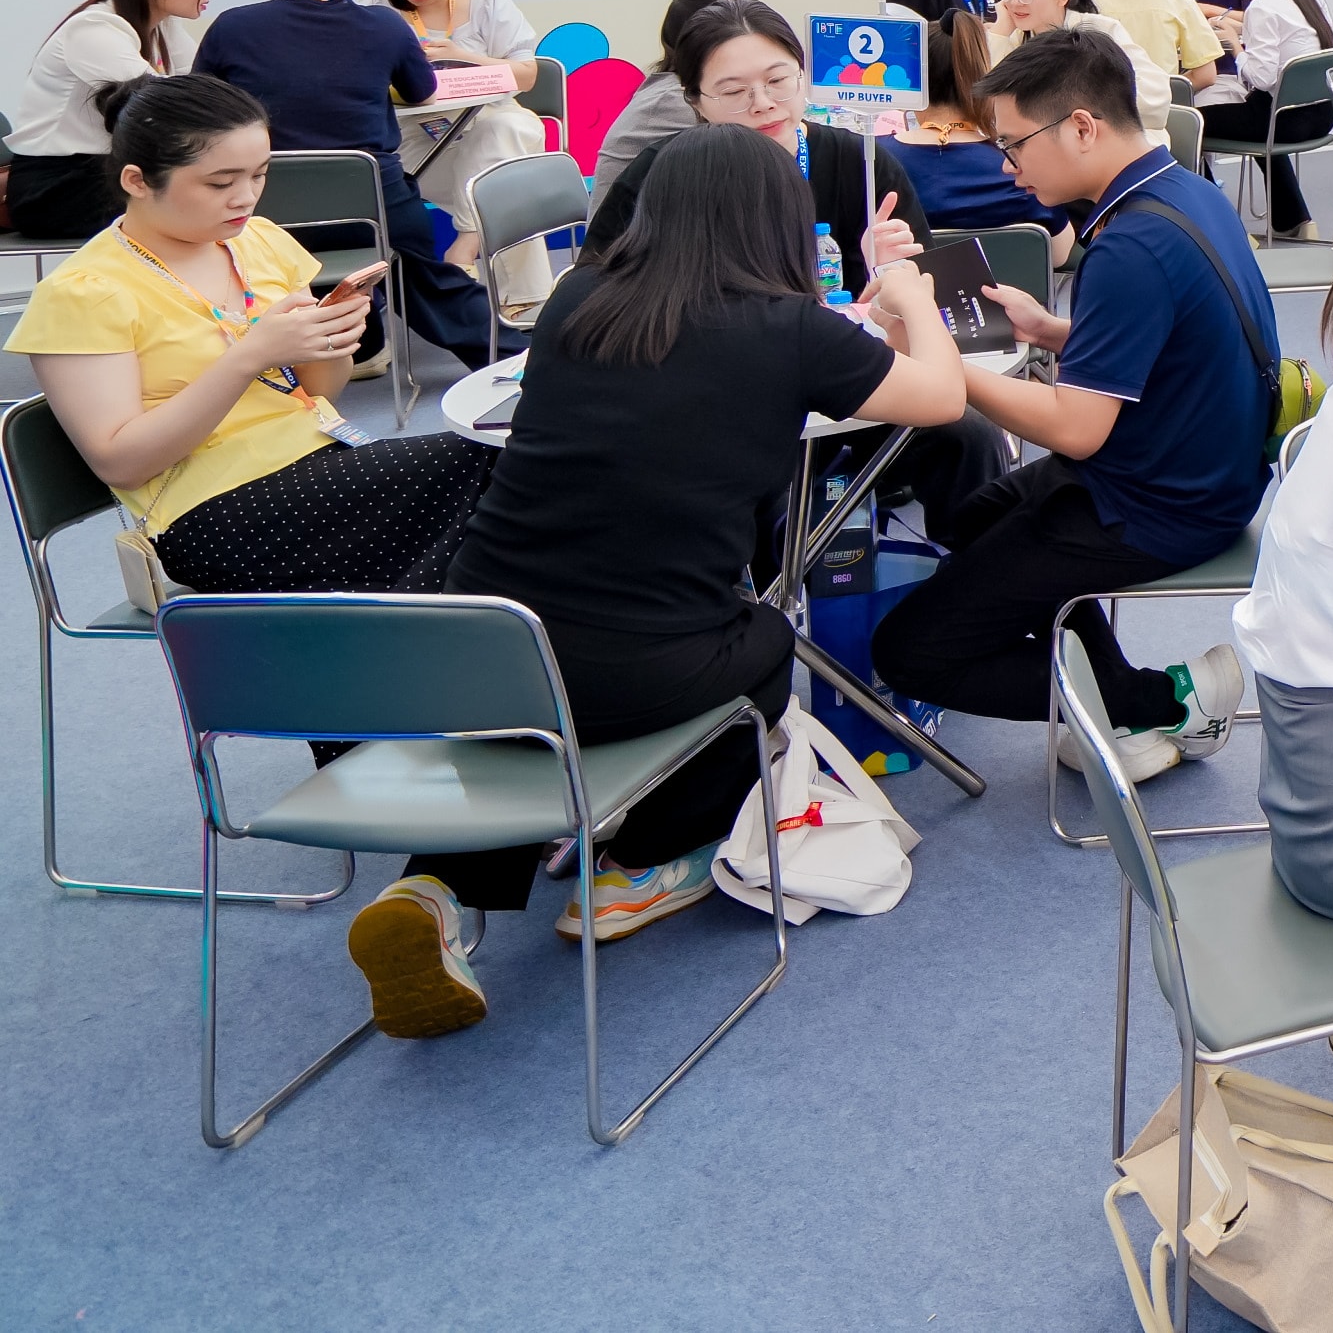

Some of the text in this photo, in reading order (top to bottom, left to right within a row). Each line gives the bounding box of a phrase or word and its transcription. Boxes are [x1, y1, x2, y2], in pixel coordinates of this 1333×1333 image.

[859, 33, 874, 55] 2
[454, 75, 490, 83] EDUCATION
[838, 91, 893, 103] VIP BUYER
